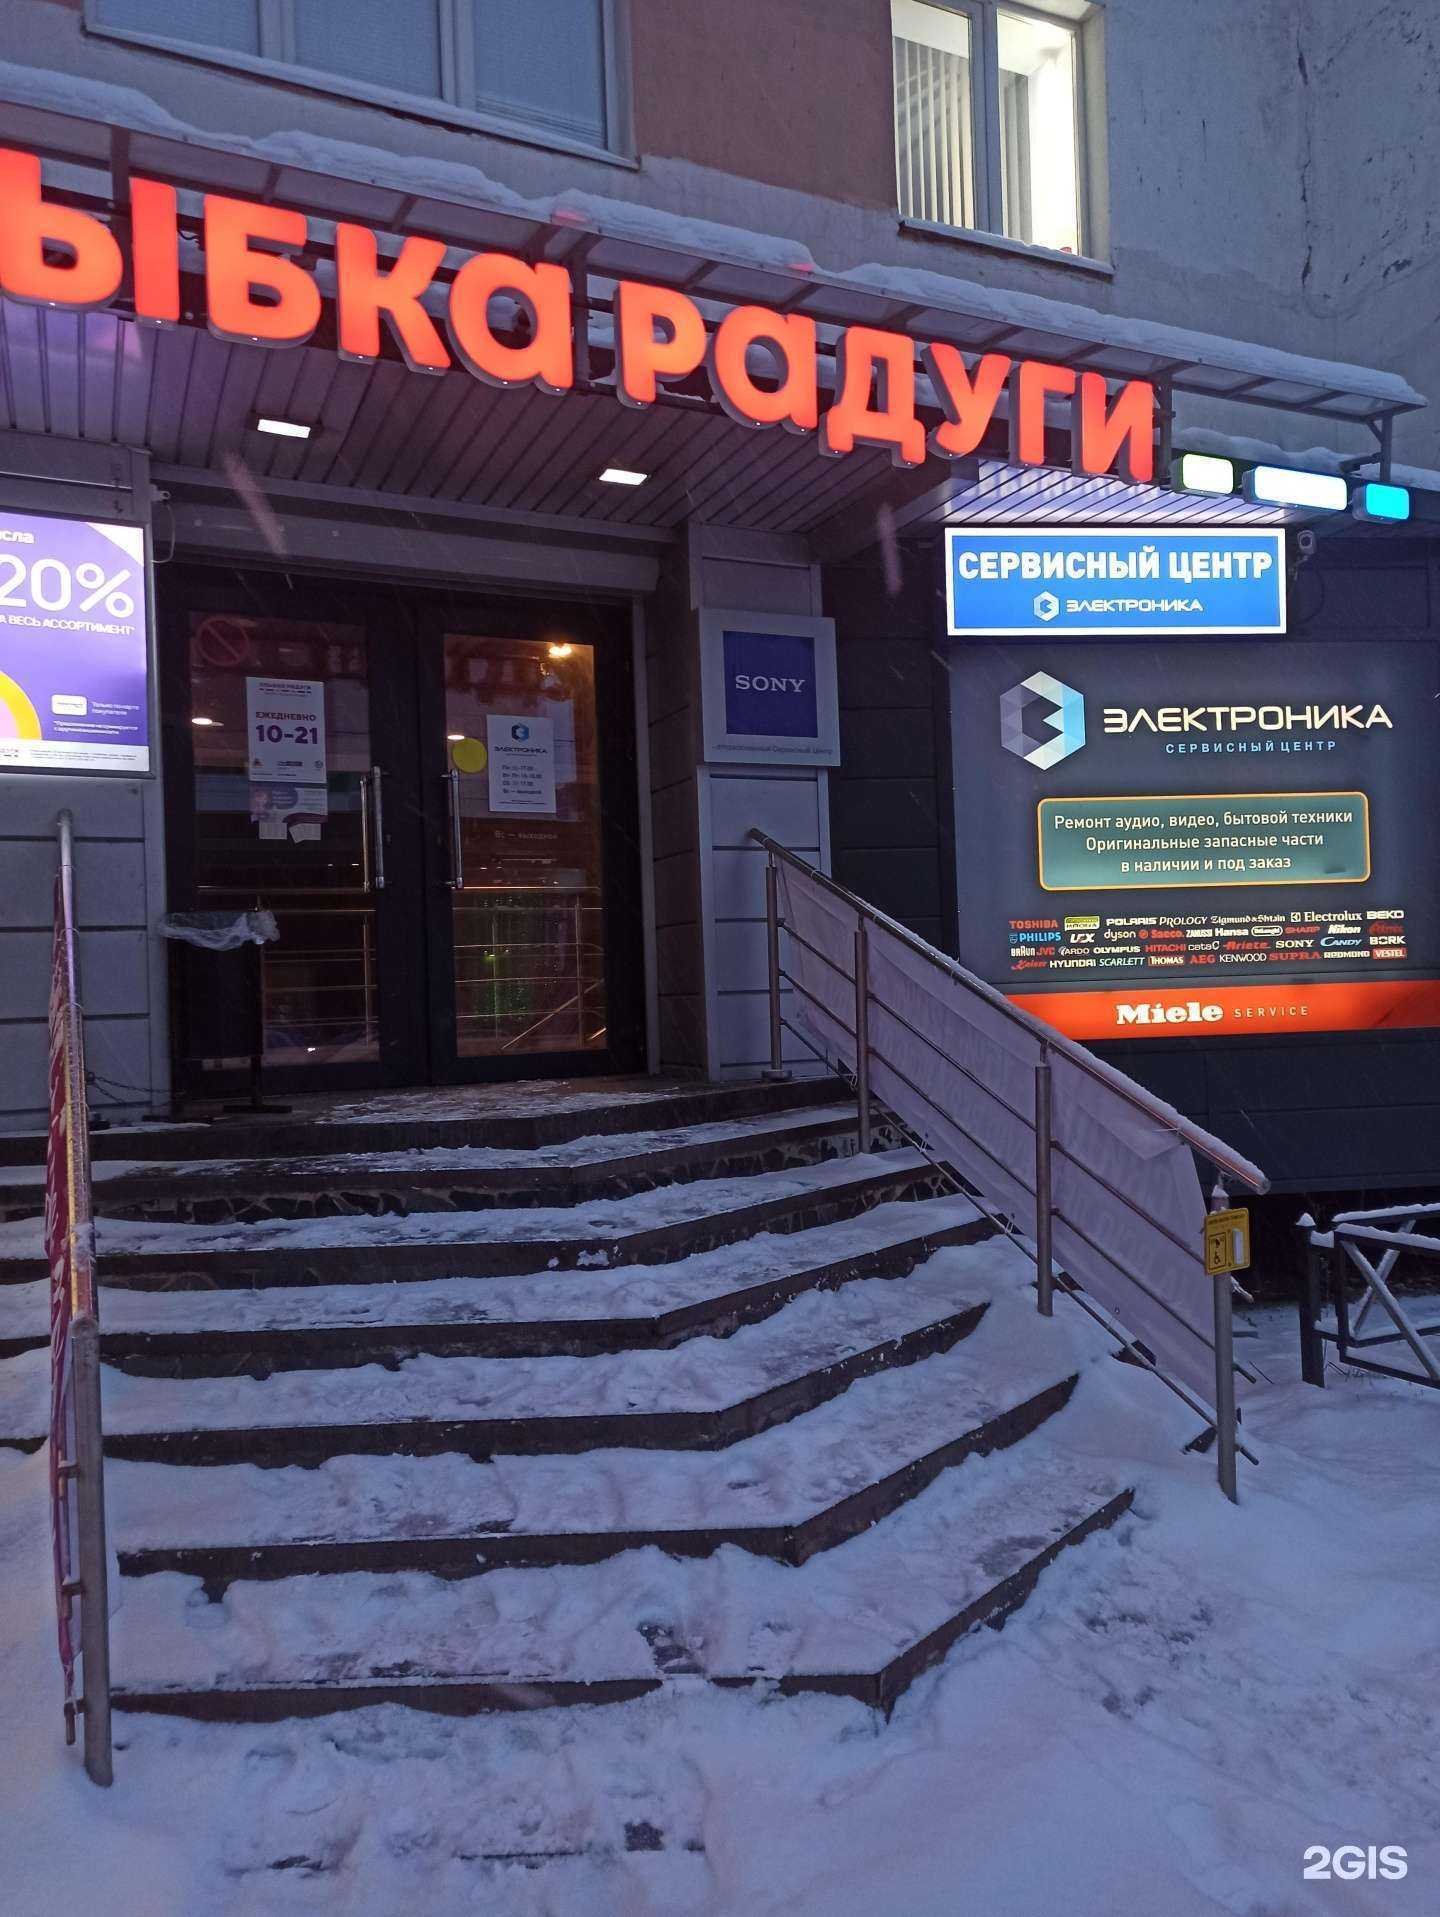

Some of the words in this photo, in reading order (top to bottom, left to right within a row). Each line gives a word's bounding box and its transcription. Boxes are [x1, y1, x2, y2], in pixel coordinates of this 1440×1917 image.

[616, 280, 1154, 484] РАДУГИ
[0, 529, 34, 544] сла
[957, 545, 1161, 580] СЕРВИСНЫЙ
[1168, 551, 1274, 584] ЦЕНТР
[1065, 598, 1204, 614] ЭЛЕКТРОНИКА
[8, 615, 41, 628] ВЕСЬ
[735, 674, 806, 693] SONY
[255, 711, 316, 722] ЕЖЕДНЕВНО
[1103, 703, 1394, 734] ЭЛЕКТРОНИКА
[255, 724, 319, 745] 10-21
[1165, 739, 1275, 754] СЕРВИСНЫЙ
[1280, 739, 1338, 755] ЦЕНТР
[1054, 815, 1111, 829] Ремонт
[1115, 815, 1165, 831] аудио,
[1169, 814, 1219, 829] видео,
[1223, 811, 1288, 826] бытовой
[1291, 811, 1353, 824] техники
[1086, 837, 1200, 853] Оригинальные
[1204, 835, 1278, 848] запасные
[1281, 834, 1324, 846] части
[1121, 861, 1130, 873] в
[1134, 859, 1200, 872] наличии
[1204, 860, 1213, 870] и
[1217, 858, 1246, 872] под
[1249, 857, 1292, 869] заказ
[1009, 920, 1058, 929] TOSHIBA
[1106, 917, 1158, 926] POLARIS
[1159, 916, 1208, 928] PROLOGY
[1304, 910, 1363, 922] Electrolux
[1366, 910, 1404, 919] BEKO
[1020, 932, 1061, 942] PHILIPS
[1104, 929, 1136, 941] dyson
[1215, 927, 1249, 937] Hansa
[1327, 924, 1361, 934] Nikon
[1037, 946, 1055, 955] JVC
[1063, 947, 1090, 956] ARDO
[1093, 946, 1141, 954] OLYMPUS
[1145, 944, 1186, 952] HITACHI
[1275, 940, 1315, 949] SONY
[1369, 935, 1406, 946] BORK
[1049, 959, 1096, 968] HYUNDAI
[1099, 957, 1145, 967] SCARLETT
[1149, 955, 1184, 966] THOMAS
[1190, 954, 1216, 965] AEG
[1220, 953, 1267, 963] KENWOOD
[1269, 951, 1321, 960] SUPRA
[1324, 950, 1370, 959] REDMOND
[1374, 949, 1405, 958] VESTEL
[1116, 1001, 1224, 1025] Miele
[1233, 1006, 1309, 1018] SERVICE
